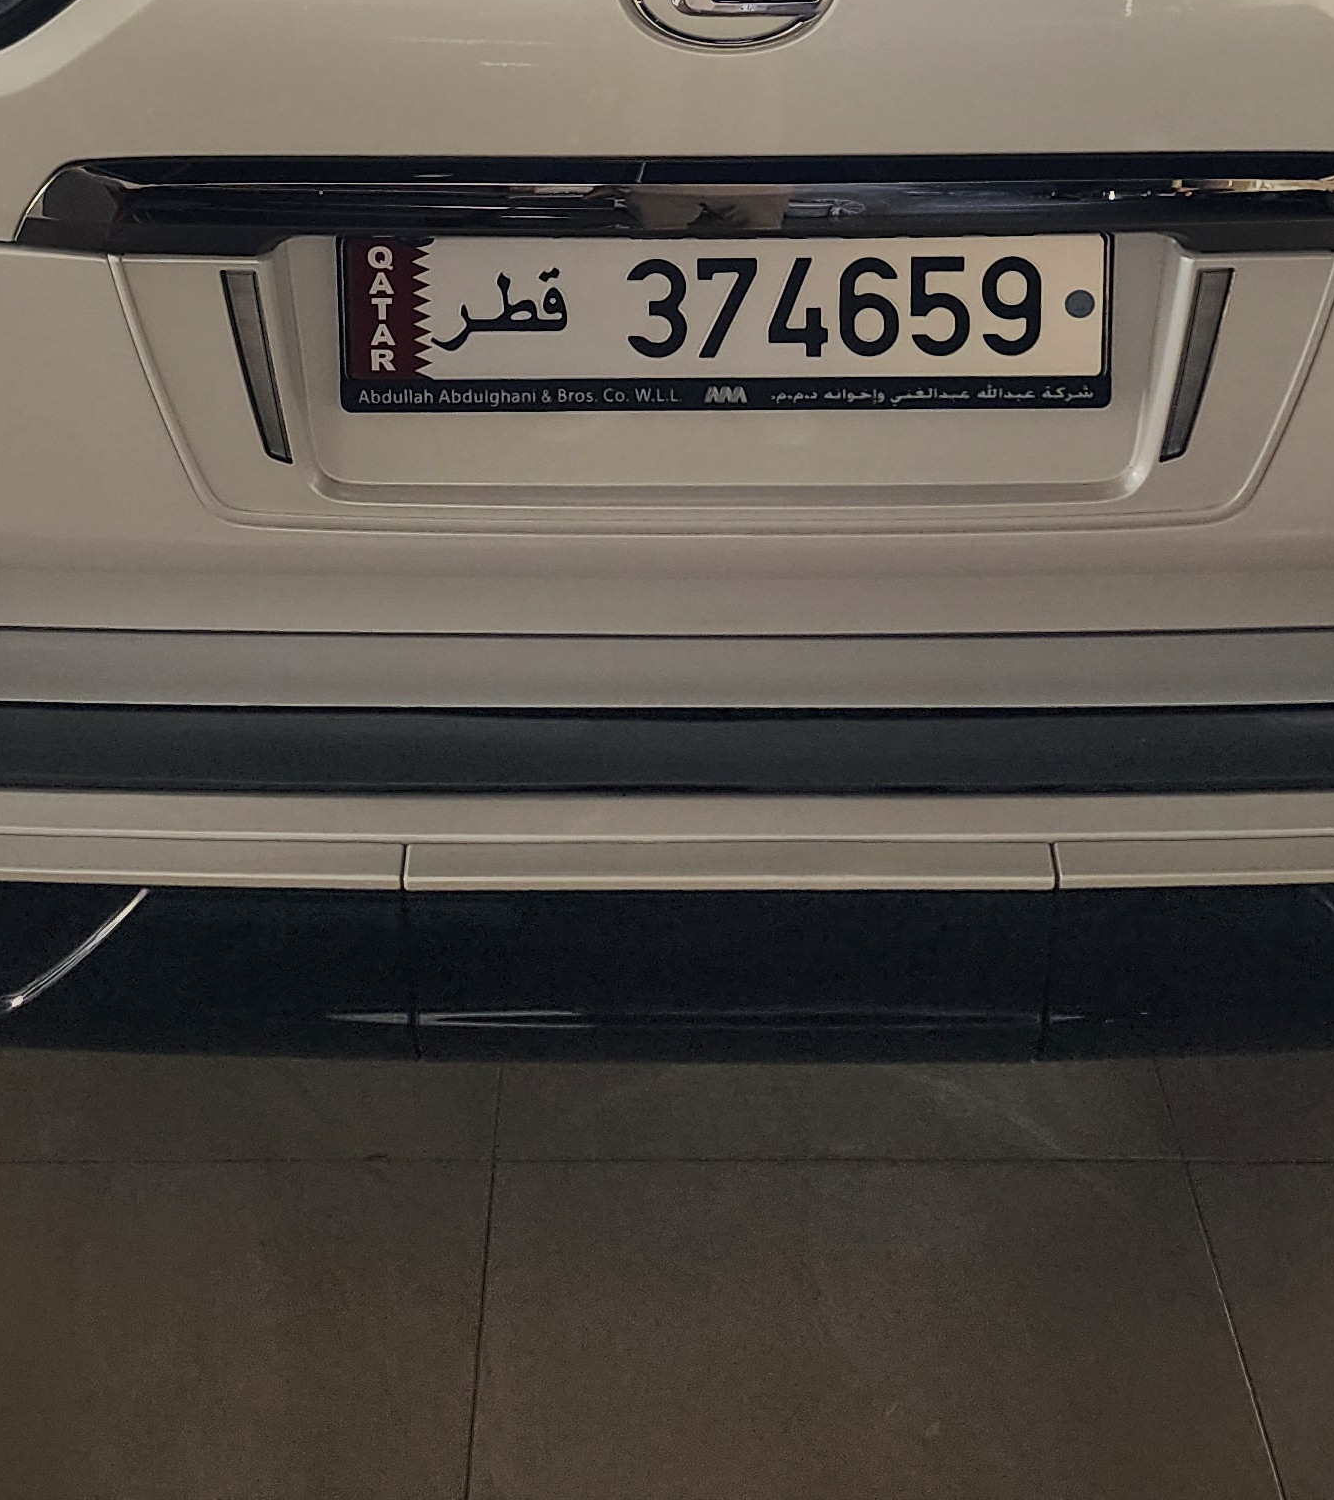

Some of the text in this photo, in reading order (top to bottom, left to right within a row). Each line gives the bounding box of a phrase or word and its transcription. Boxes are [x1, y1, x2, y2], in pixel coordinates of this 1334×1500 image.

[367, 245, 397, 372] QATAR
[430, 265, 568, 351] قطر
[626, 256, 1041, 358] 374659
[358, 388, 433, 405] Abdullah
[438, 388, 536, 407] Abdulghani
[541, 389, 552, 404] &
[557, 389, 597, 404] Bros.
[603, 389, 629, 404] Co.
[890, 387, 971, 406] عبدالغني
[977, 383, 1036, 400] عبدالله
[1042, 384, 1094, 400] شركة
